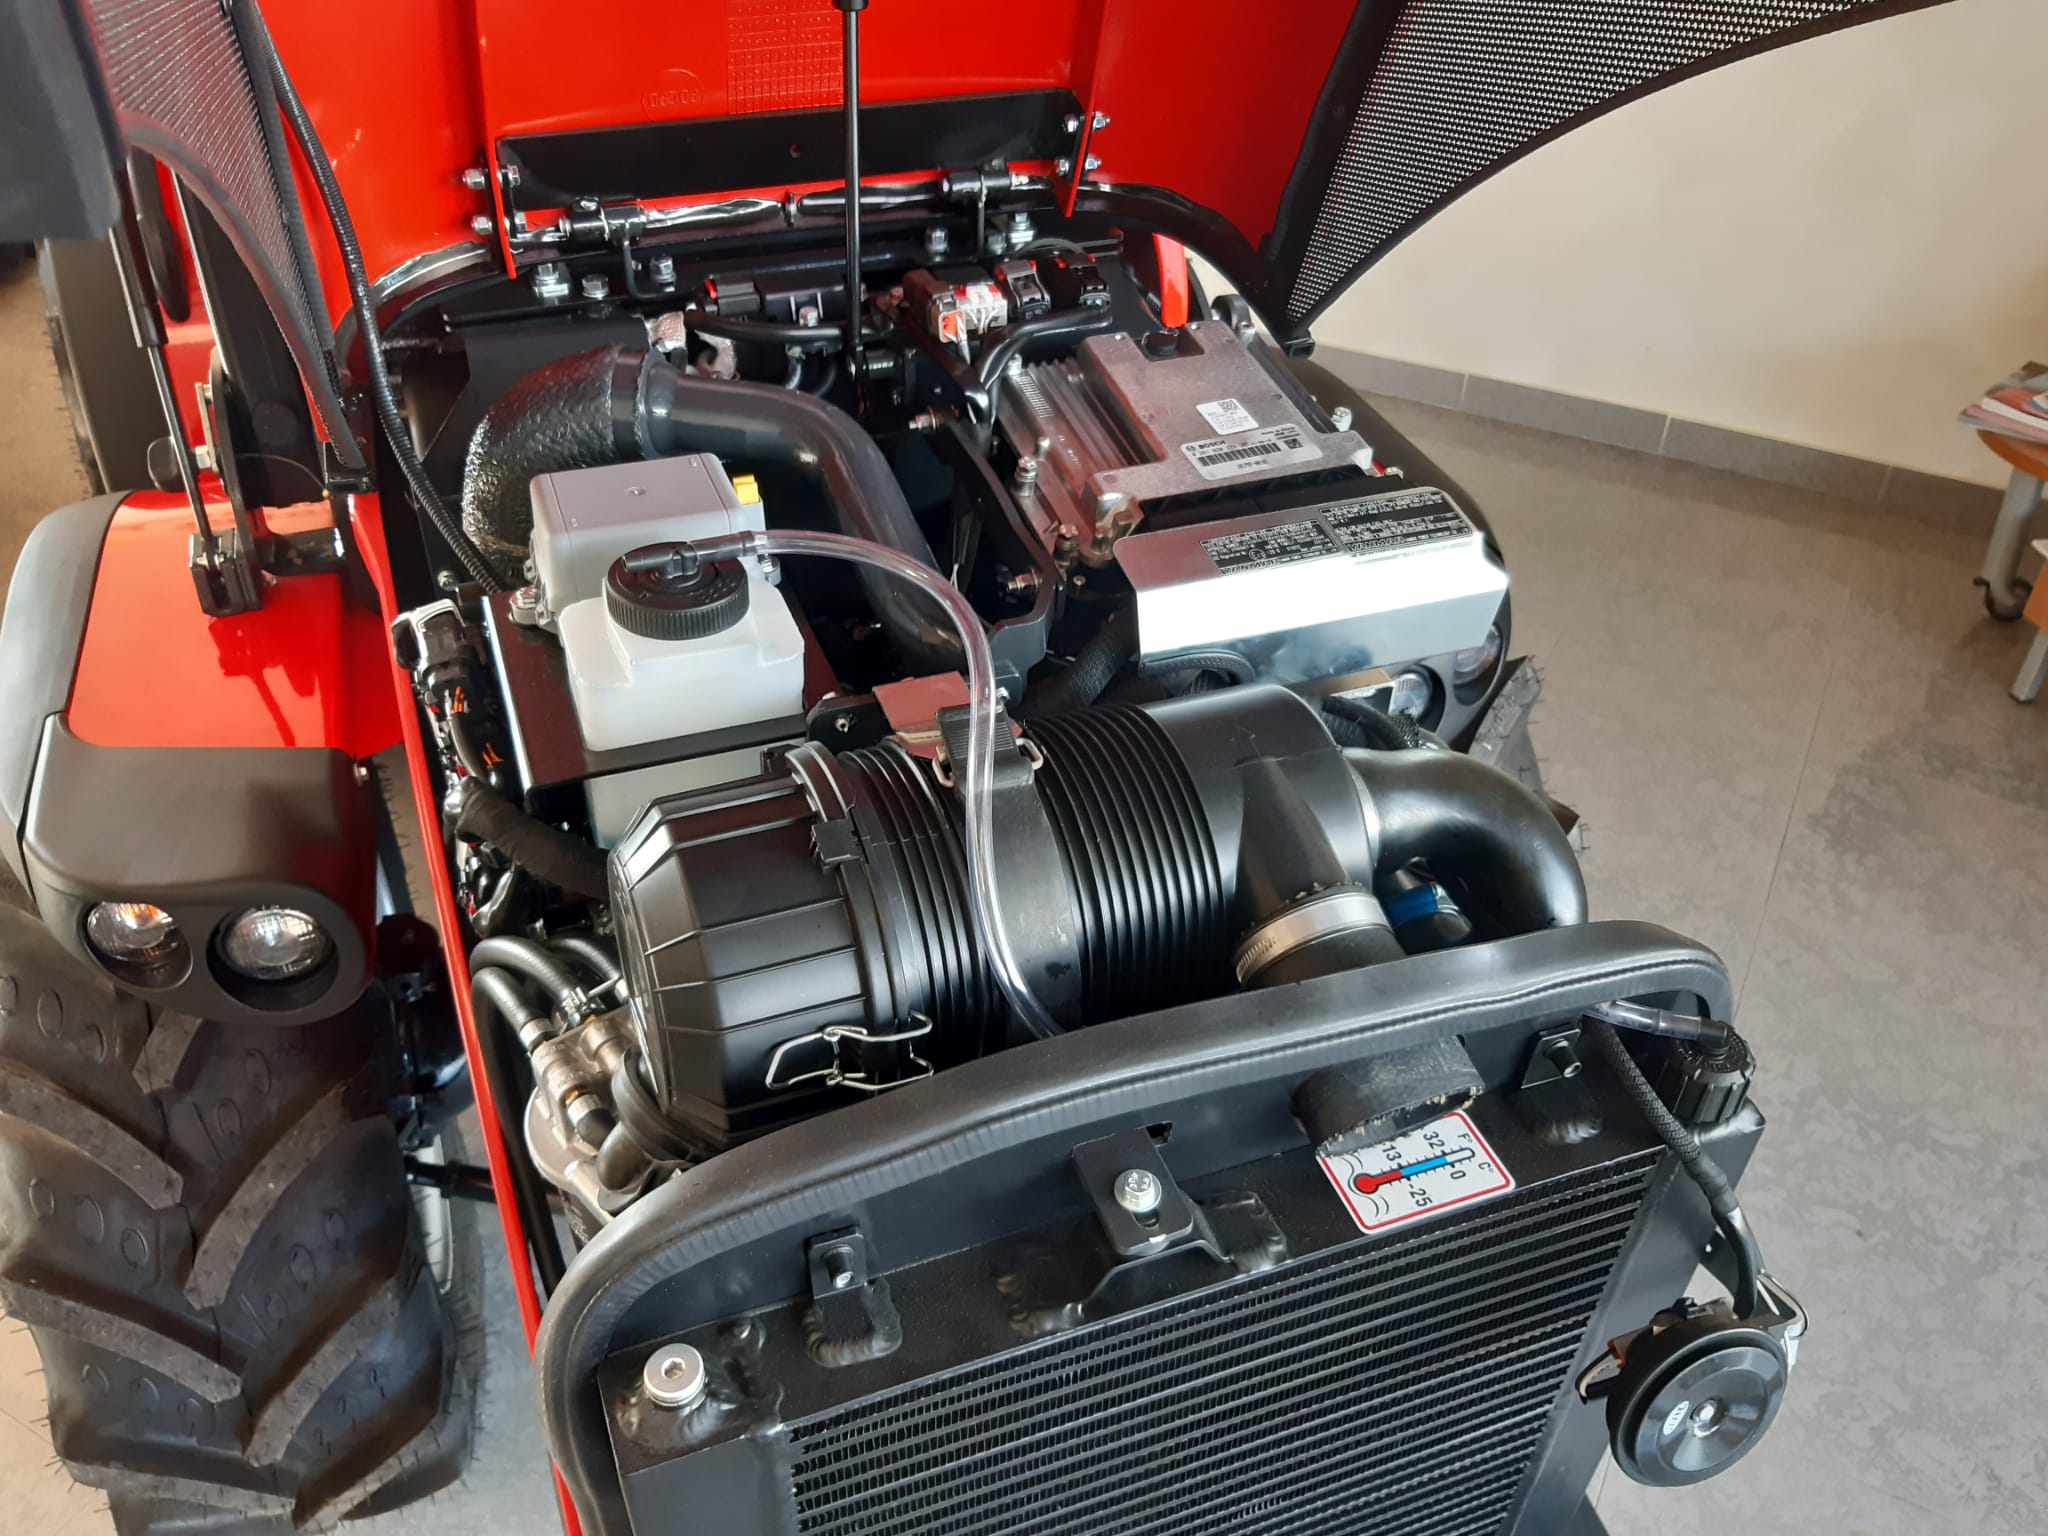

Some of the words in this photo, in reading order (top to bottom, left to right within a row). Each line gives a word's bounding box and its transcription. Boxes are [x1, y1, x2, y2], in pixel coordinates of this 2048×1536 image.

[1198, 440, 1226, 450] BOSCH
[1423, 1131, 1445, 1149] 32
[1409, 1183, 1433, 1207] -25
